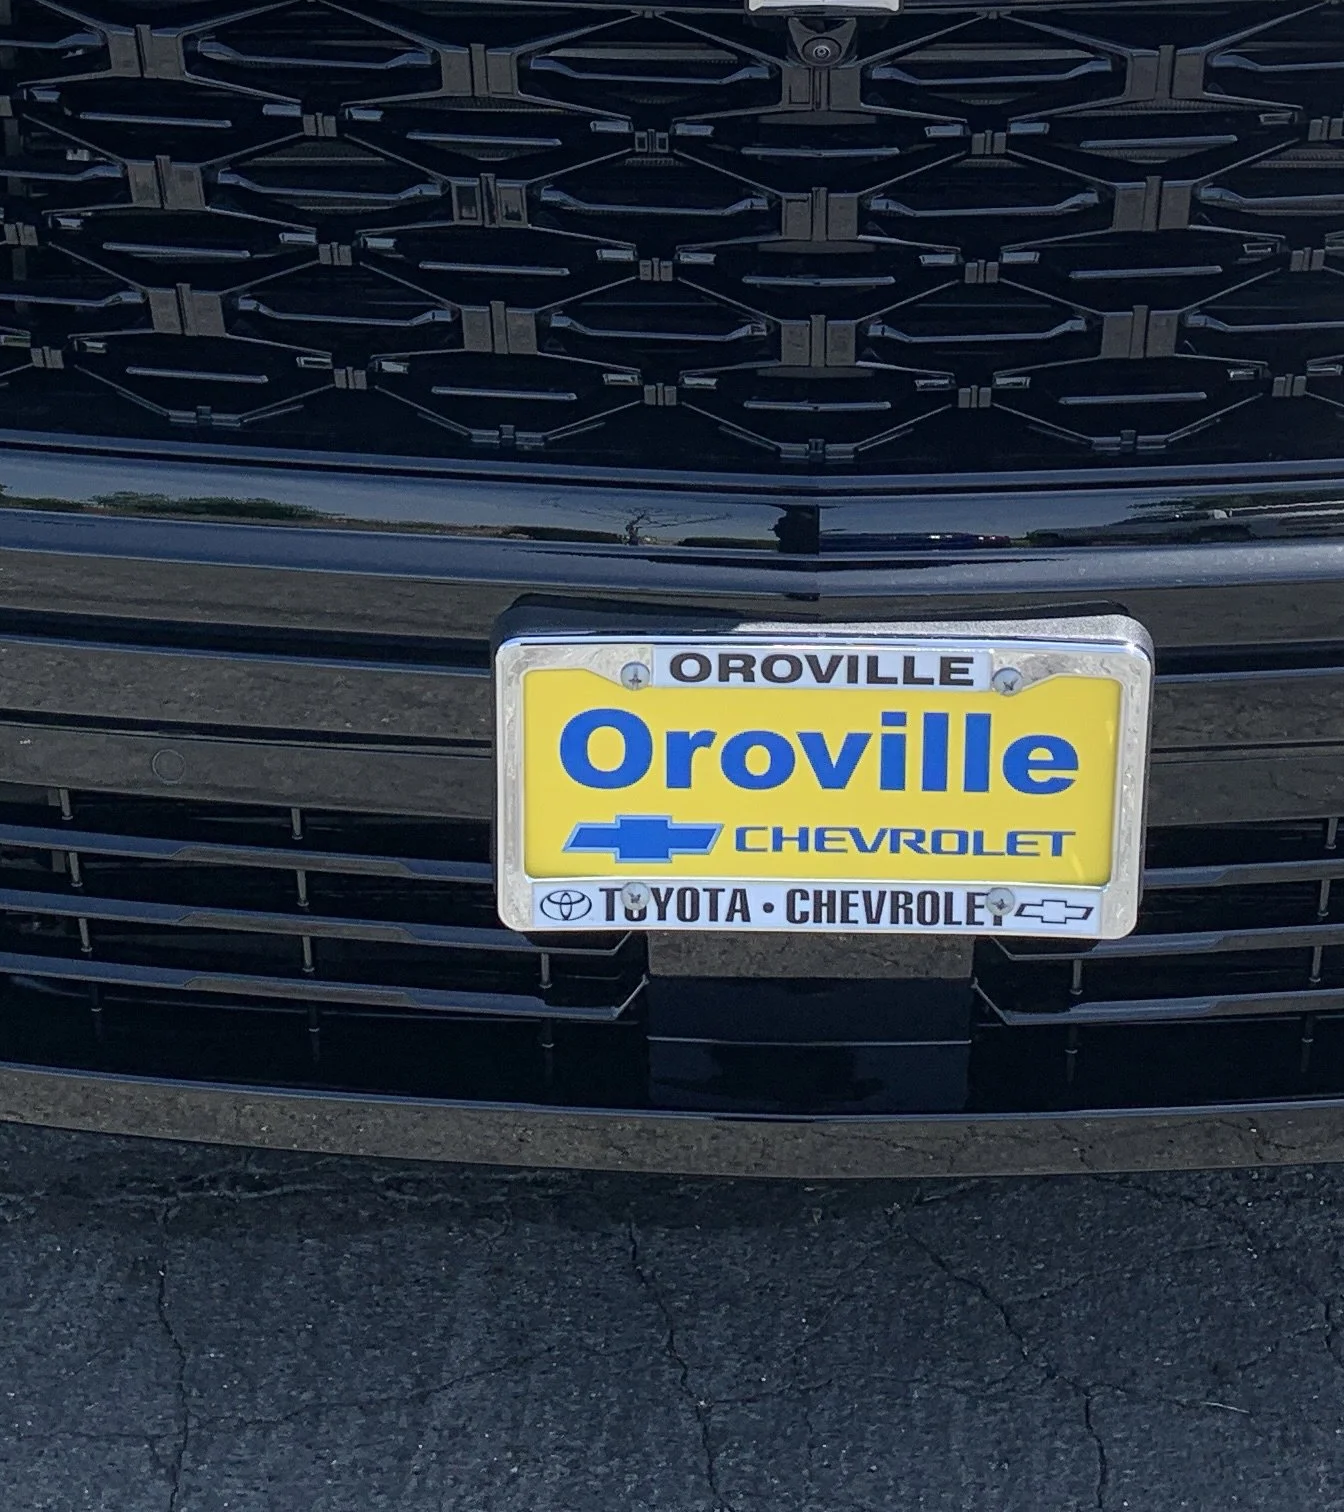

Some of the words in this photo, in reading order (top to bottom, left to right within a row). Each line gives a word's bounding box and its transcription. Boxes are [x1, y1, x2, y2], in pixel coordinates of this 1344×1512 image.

[669, 651, 975, 687] OROVILLE
[558, 707, 1080, 796] Oroville
[734, 825, 1077, 858] CHEVROLET
